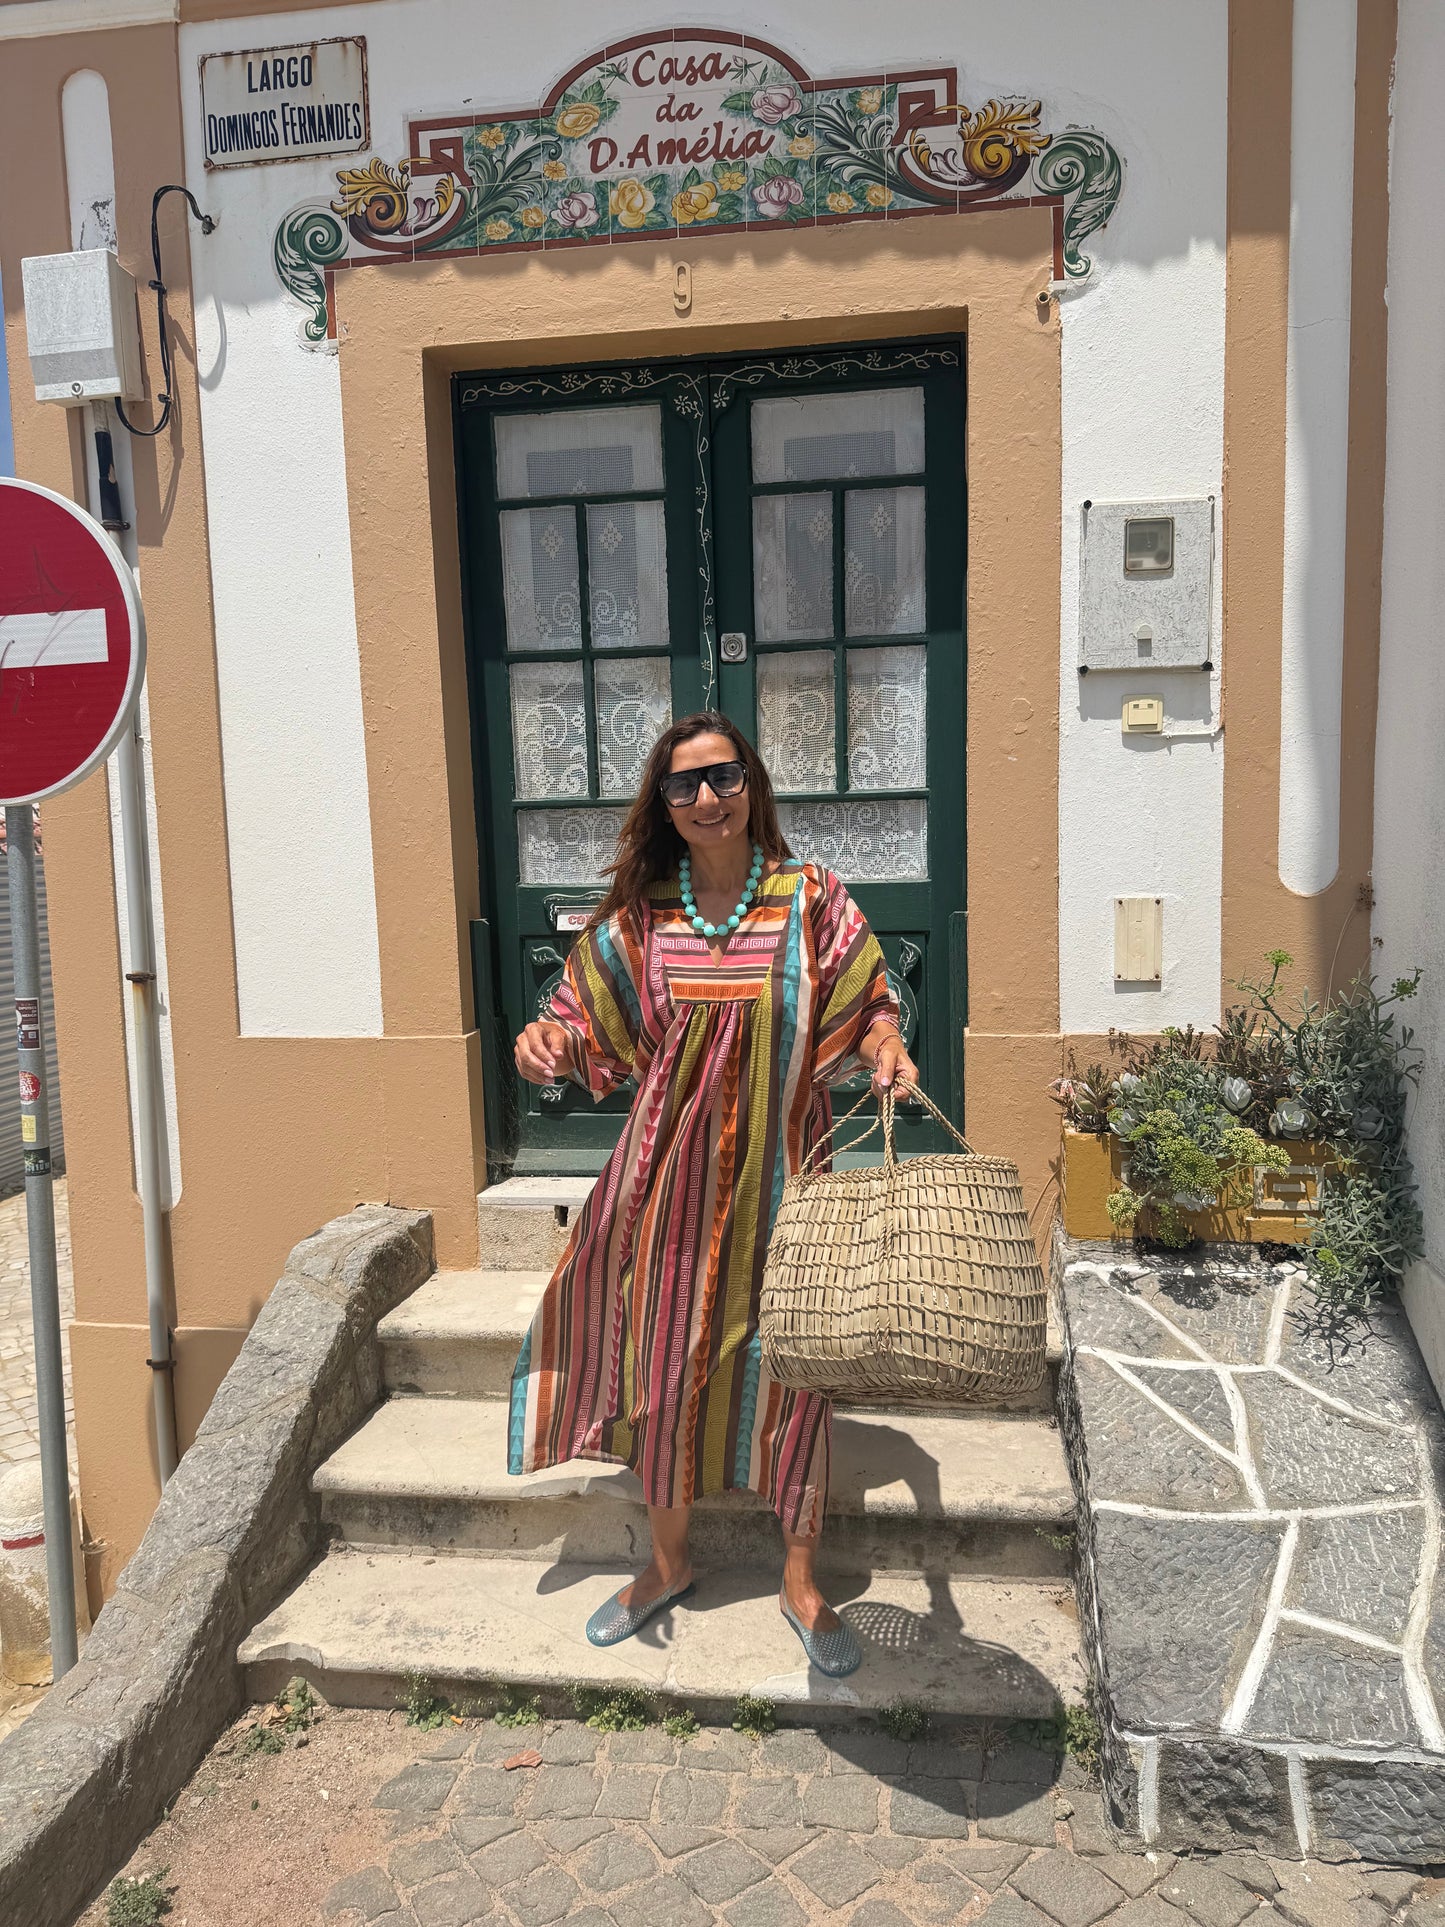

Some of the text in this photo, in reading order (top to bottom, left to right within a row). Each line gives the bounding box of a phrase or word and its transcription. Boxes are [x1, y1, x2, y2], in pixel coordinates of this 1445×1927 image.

[248, 55, 313, 93] LARGO
[632, 50, 732, 87] Casa
[656, 93, 703, 123] da
[208, 102, 362, 155] DOMINGOS FERNANDES
